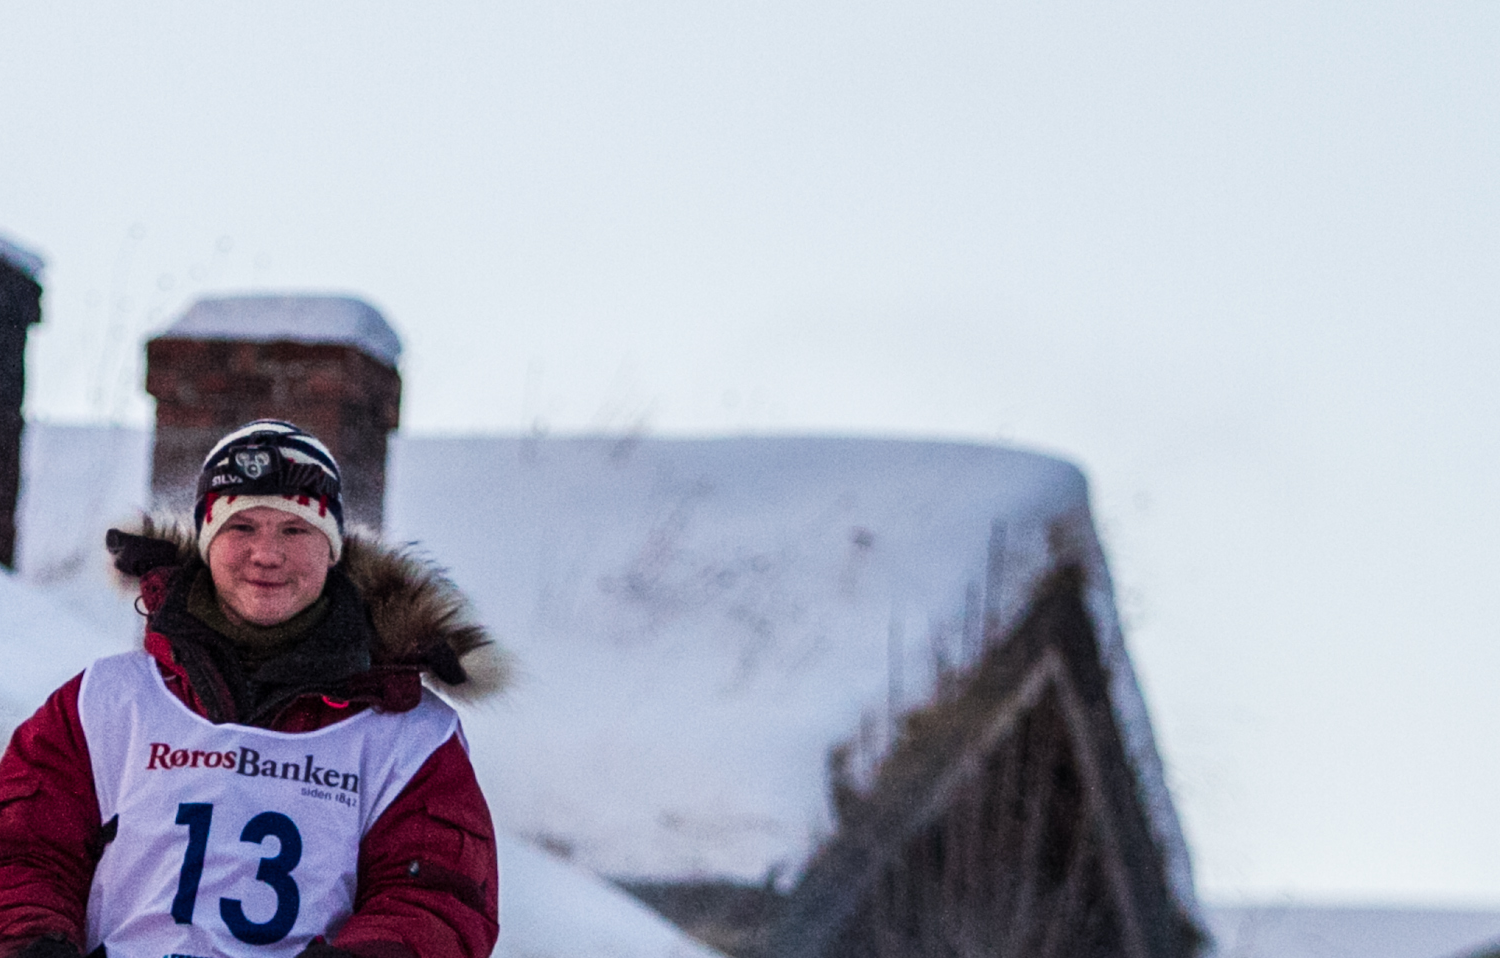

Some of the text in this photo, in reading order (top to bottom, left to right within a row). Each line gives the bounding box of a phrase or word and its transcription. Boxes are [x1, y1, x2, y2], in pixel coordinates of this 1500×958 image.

[146, 743, 359, 793] RørosBanken
[301, 787, 358, 808] siden 1842
[171, 802, 303, 946] 13
